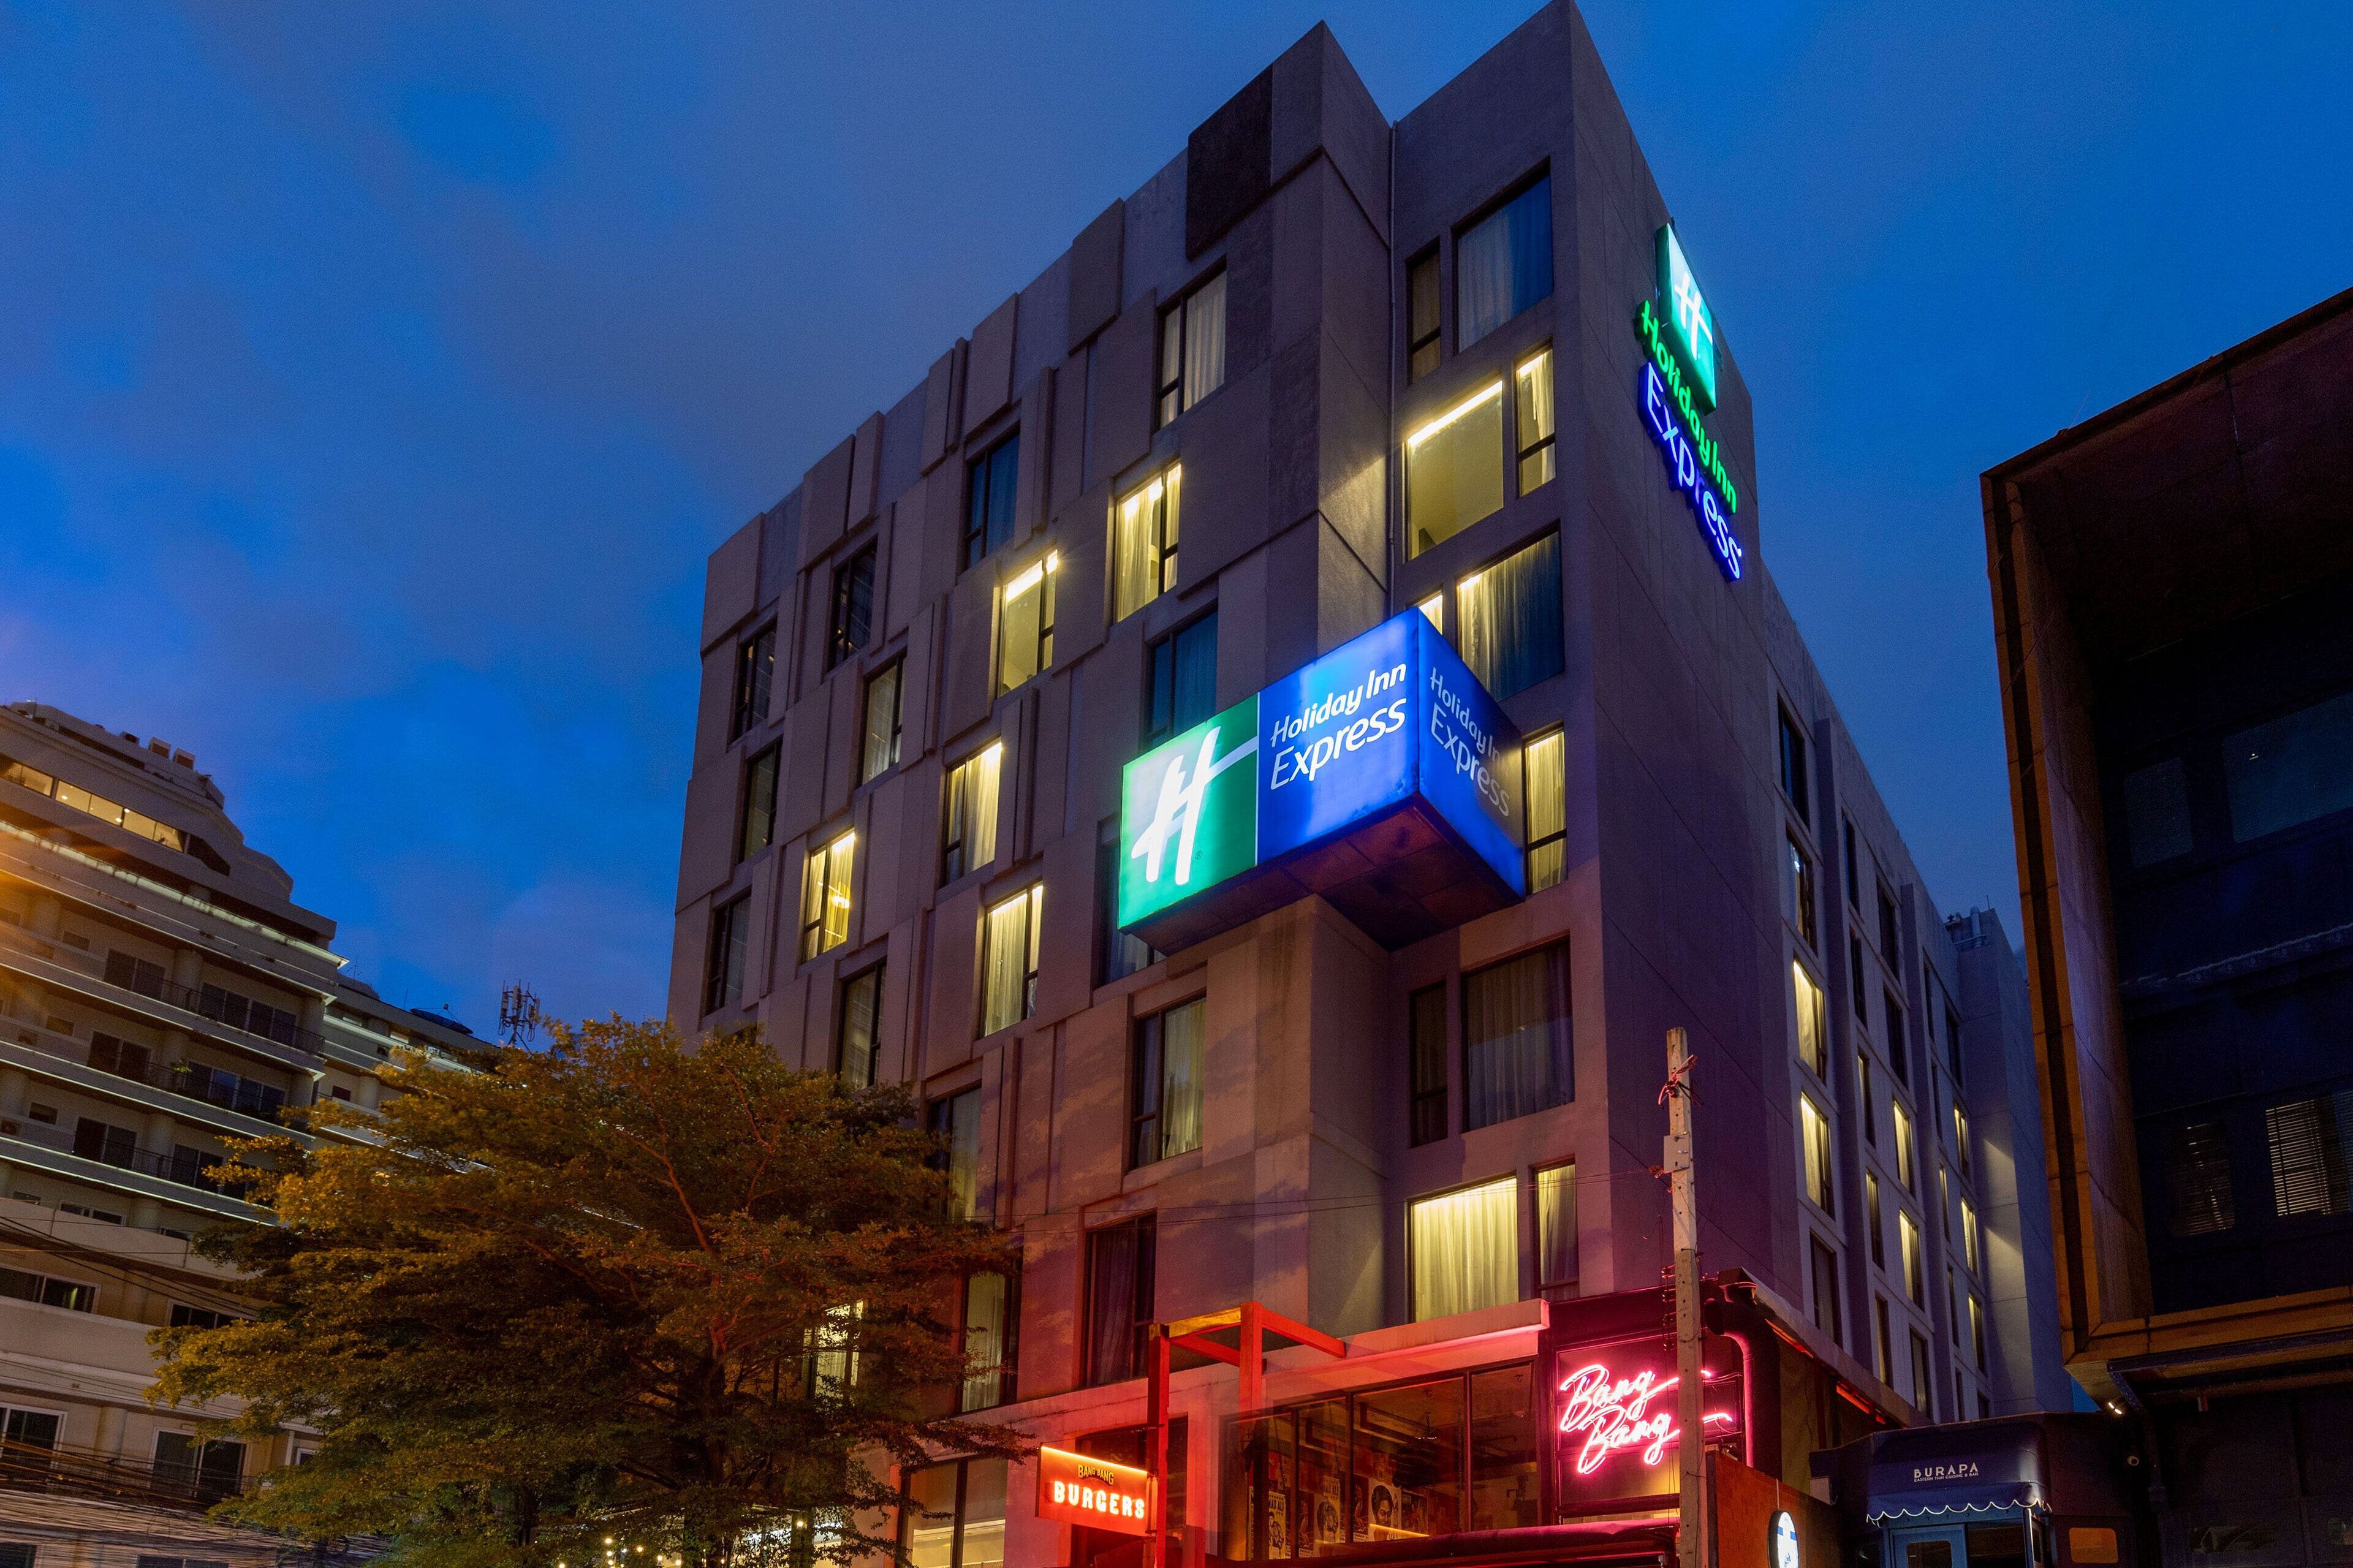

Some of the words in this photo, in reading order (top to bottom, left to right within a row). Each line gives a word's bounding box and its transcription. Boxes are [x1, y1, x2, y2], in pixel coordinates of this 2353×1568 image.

[1642, 300, 1710, 468] Holiday
[1711, 441, 1737, 513] Inn
[1647, 362, 1741, 578] Express
[1270, 685, 1364, 748] Holiday
[1366, 664, 1407, 699] Inn
[1270, 698, 1407, 790] Express
[1430, 667, 1487, 754] Holiday
[1431, 702, 1509, 817] Express
[1560, 1365, 1680, 1431] Bang
[1577, 1404, 1680, 1474] Bang
[1054, 1480, 1145, 1519] BURGERS
[1914, 1461, 1979, 1479] BURAPA
